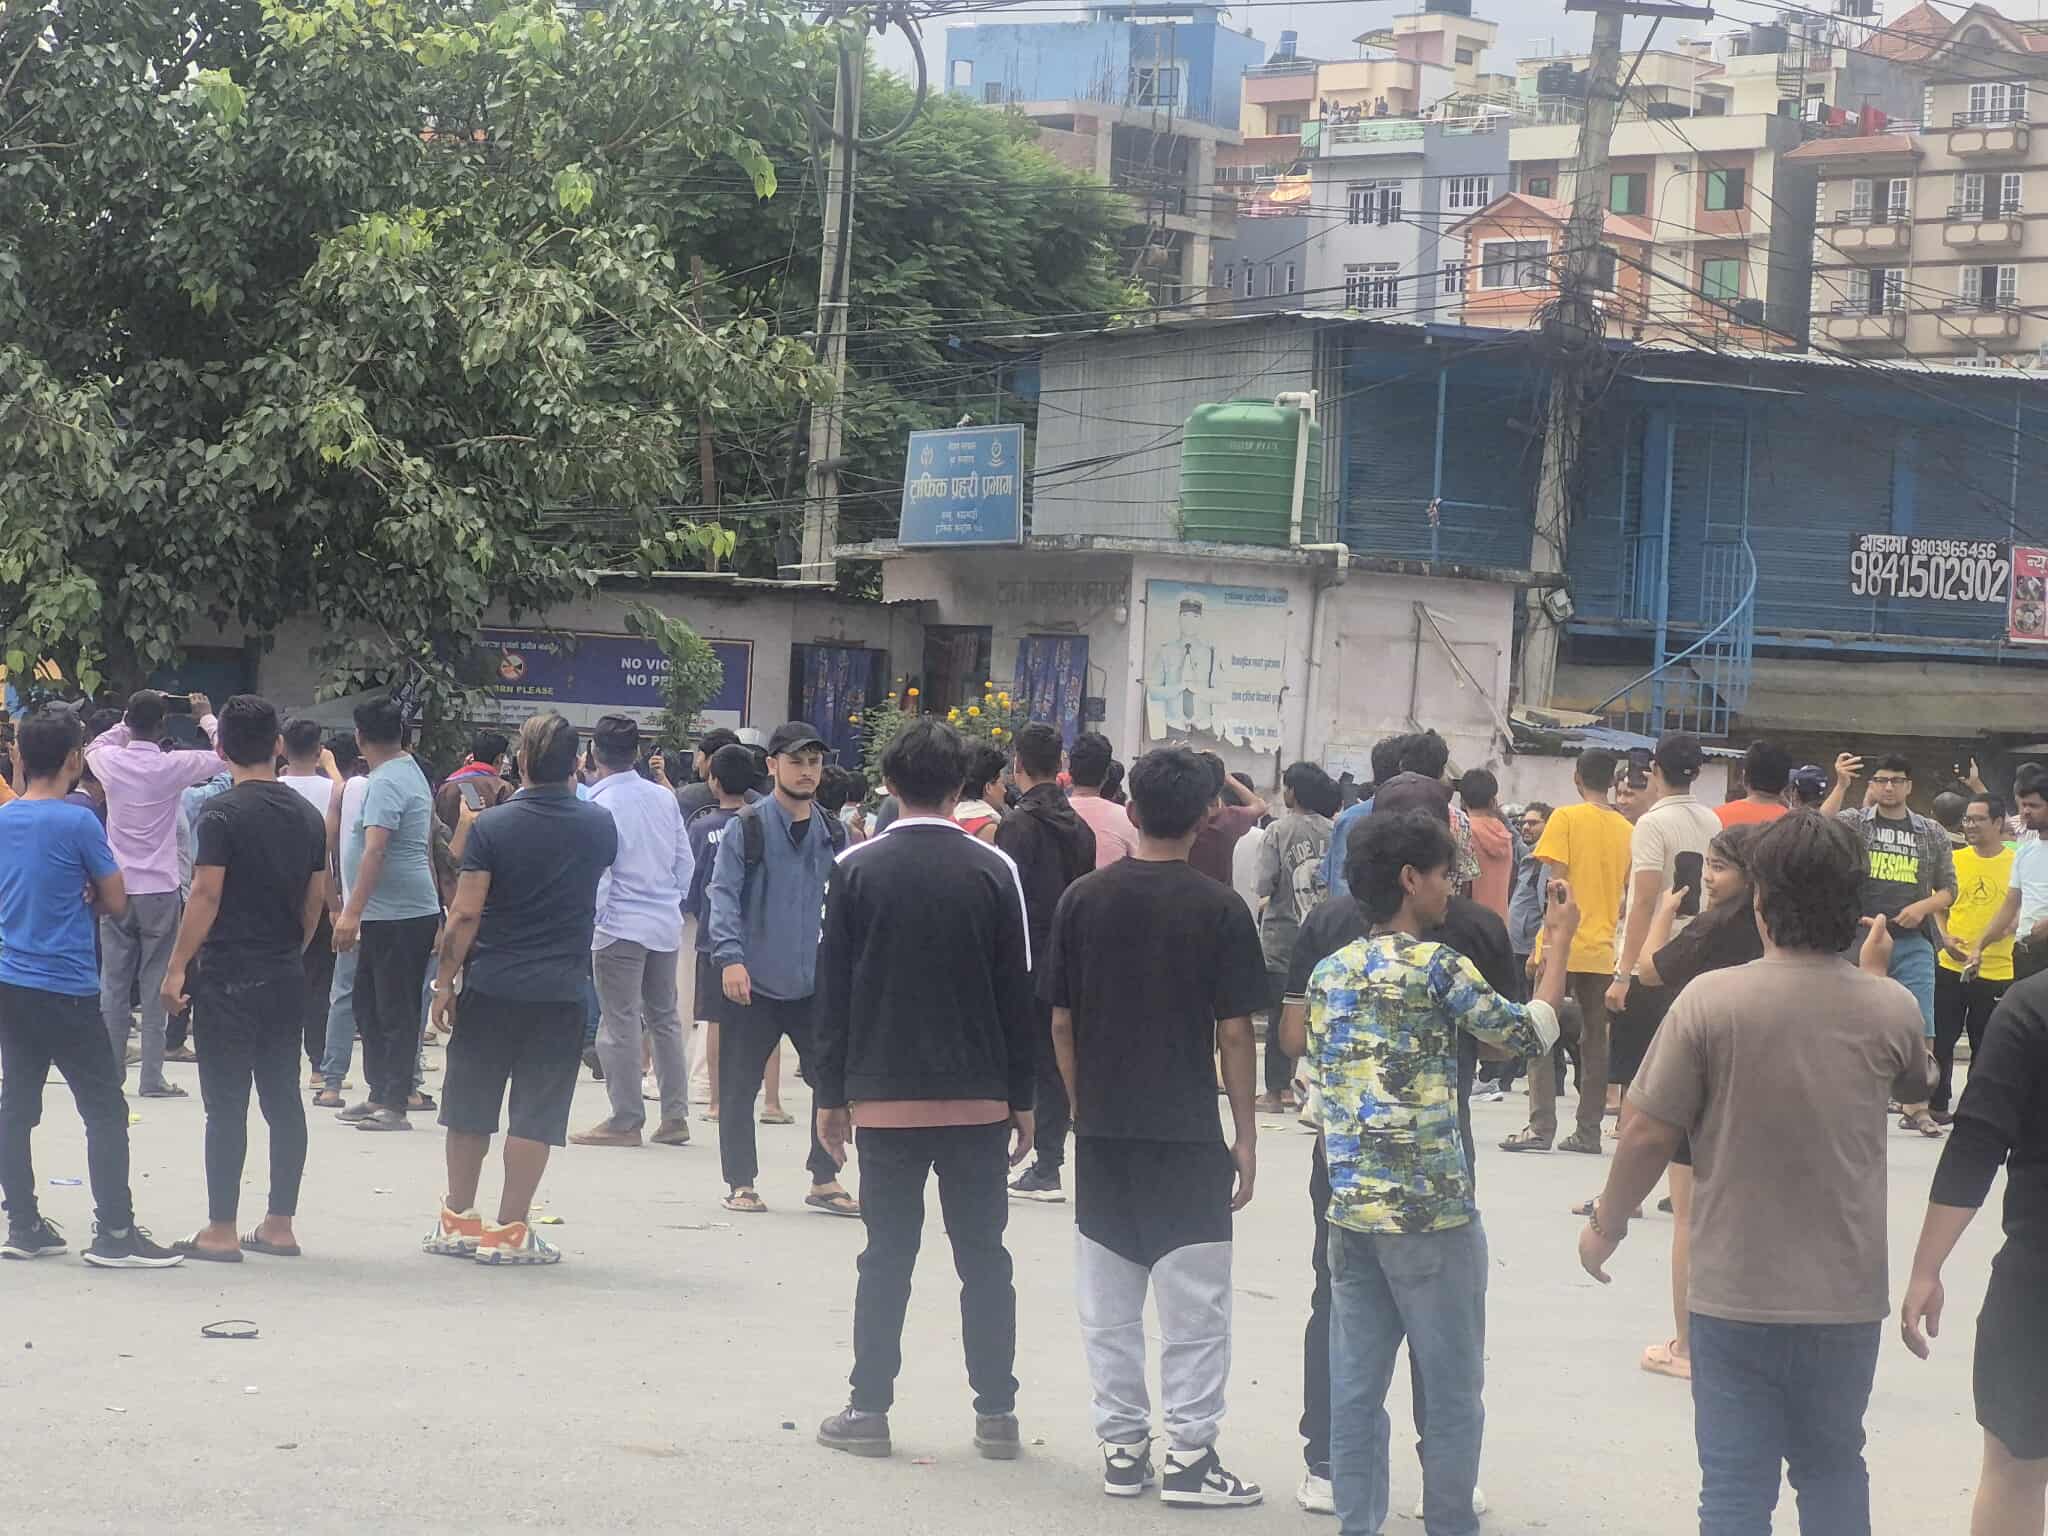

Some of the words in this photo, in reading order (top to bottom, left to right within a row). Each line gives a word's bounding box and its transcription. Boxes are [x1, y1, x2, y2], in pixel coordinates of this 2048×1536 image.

[1860, 534, 1908, 553] भाडामा
[1911, 538, 1997, 559] 9803965456
[1851, 551, 2009, 603] 9841502902
[621, 658, 642, 669] NO
[626, 674, 647, 686] NO
[516, 685, 554, 695] PLEASE
[1897, 831, 1917, 847] BAL
